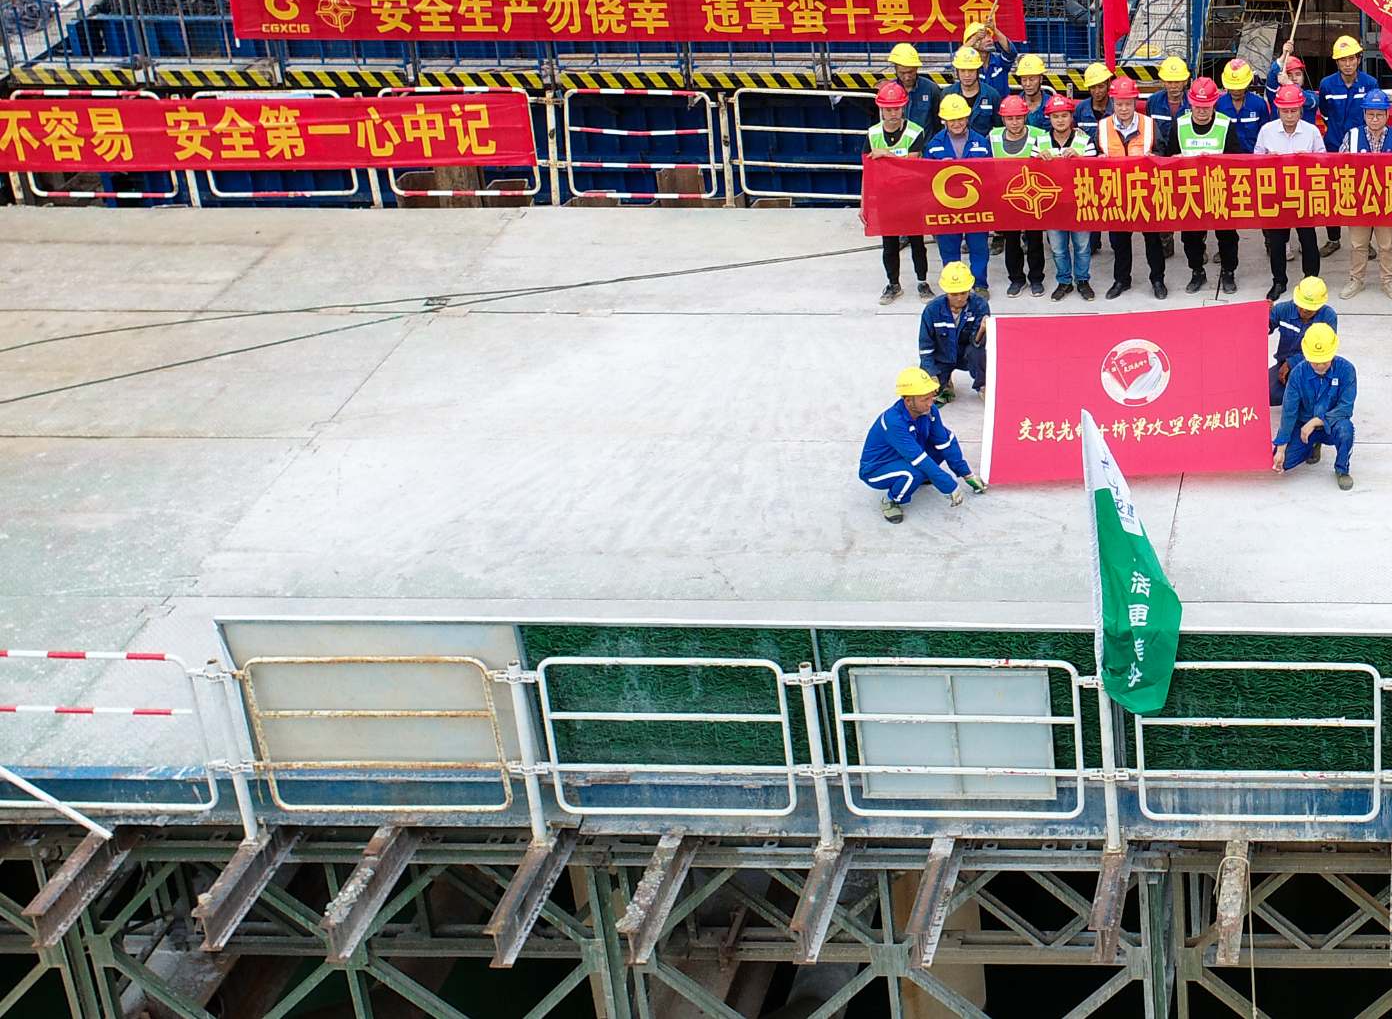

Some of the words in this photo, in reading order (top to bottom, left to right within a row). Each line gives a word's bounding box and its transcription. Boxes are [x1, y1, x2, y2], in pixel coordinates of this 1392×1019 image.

[262, 23, 310, 33] CGXCIG
[0, 106, 134, 162] 不容易
[166, 104, 497, 161] 安全第一心中记
[925, 211, 995, 226] CGXCIG
